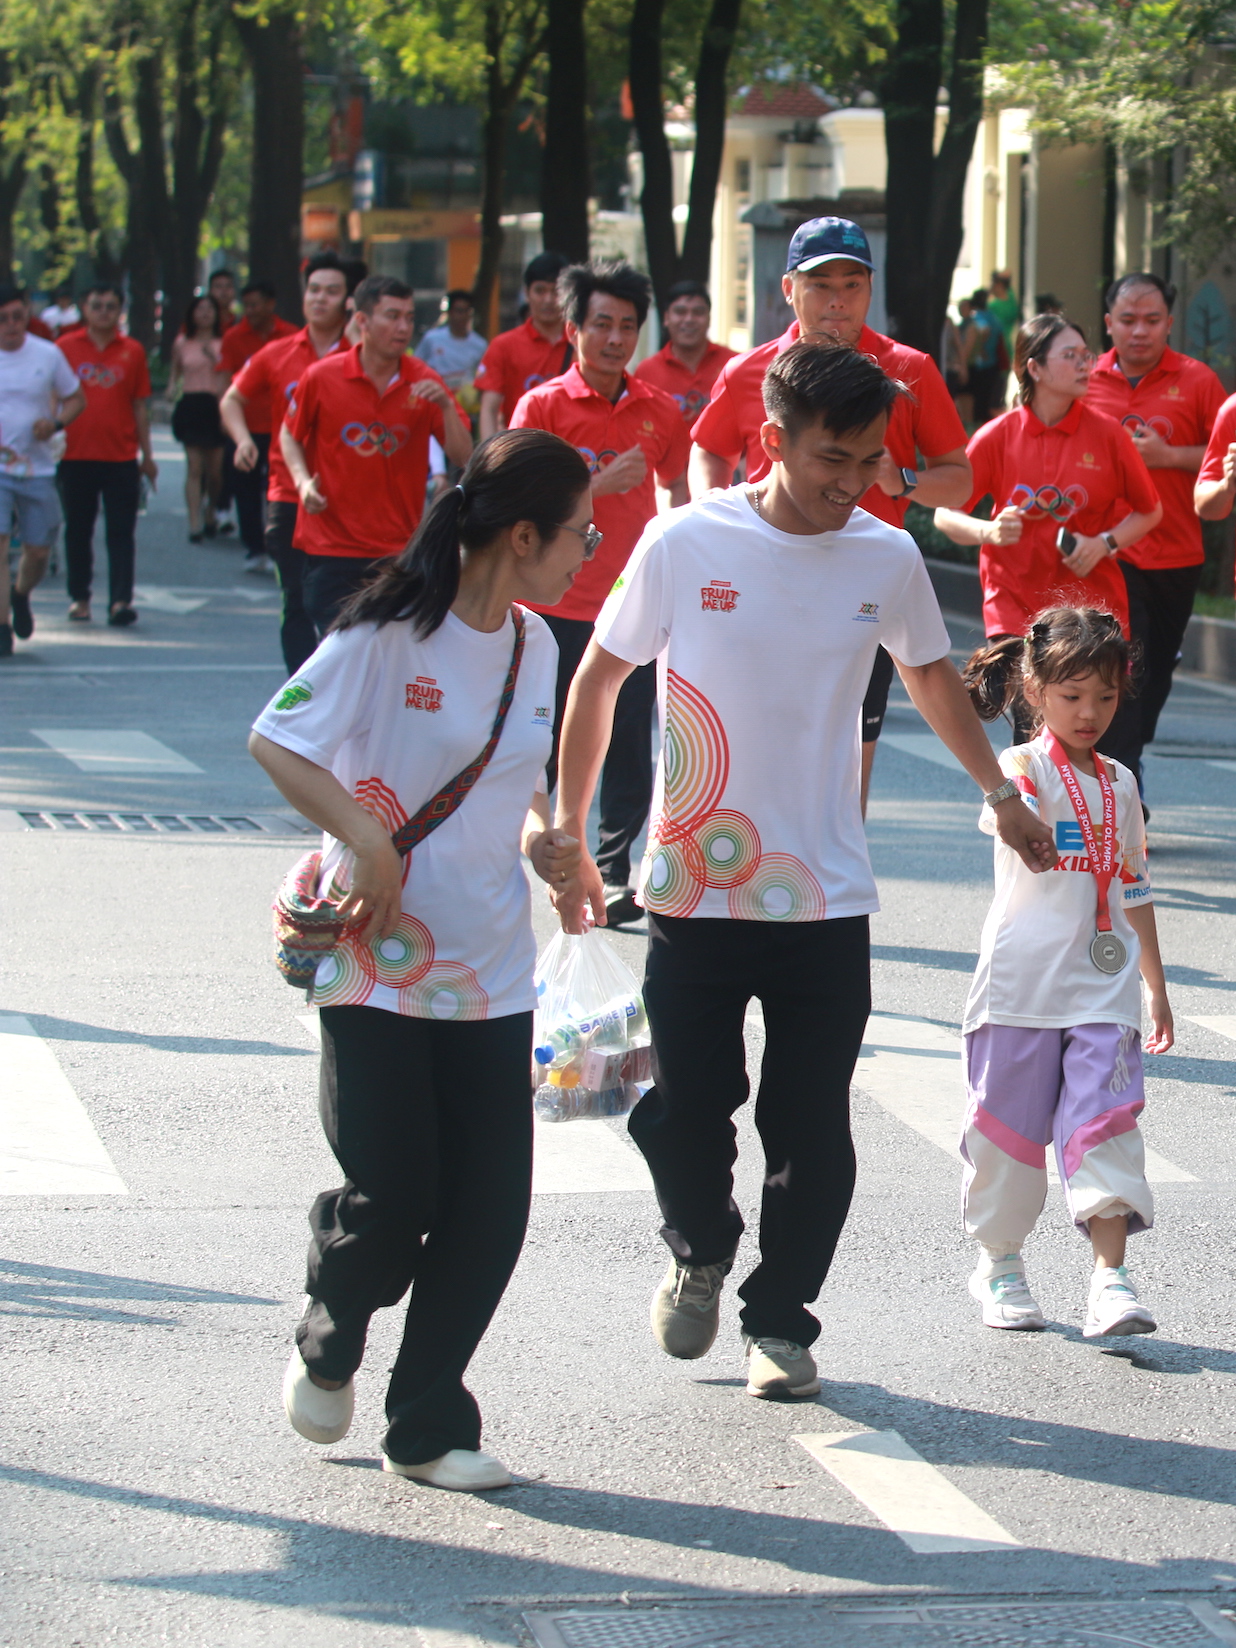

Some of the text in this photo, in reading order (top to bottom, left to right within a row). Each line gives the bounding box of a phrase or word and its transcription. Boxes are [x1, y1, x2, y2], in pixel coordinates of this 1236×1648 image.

[701, 587, 741, 602] FRUIT
[702, 600, 737, 613] ME UP
[405, 684, 445, 702] FRUIT
[405, 697, 443, 713] ME UP
[1060, 764, 1075, 785] DÂN
[1070, 785, 1086, 811] TOÀN
[1103, 798, 1113, 826] CHẠY
[1103, 828, 1113, 871] OLYMPIC
